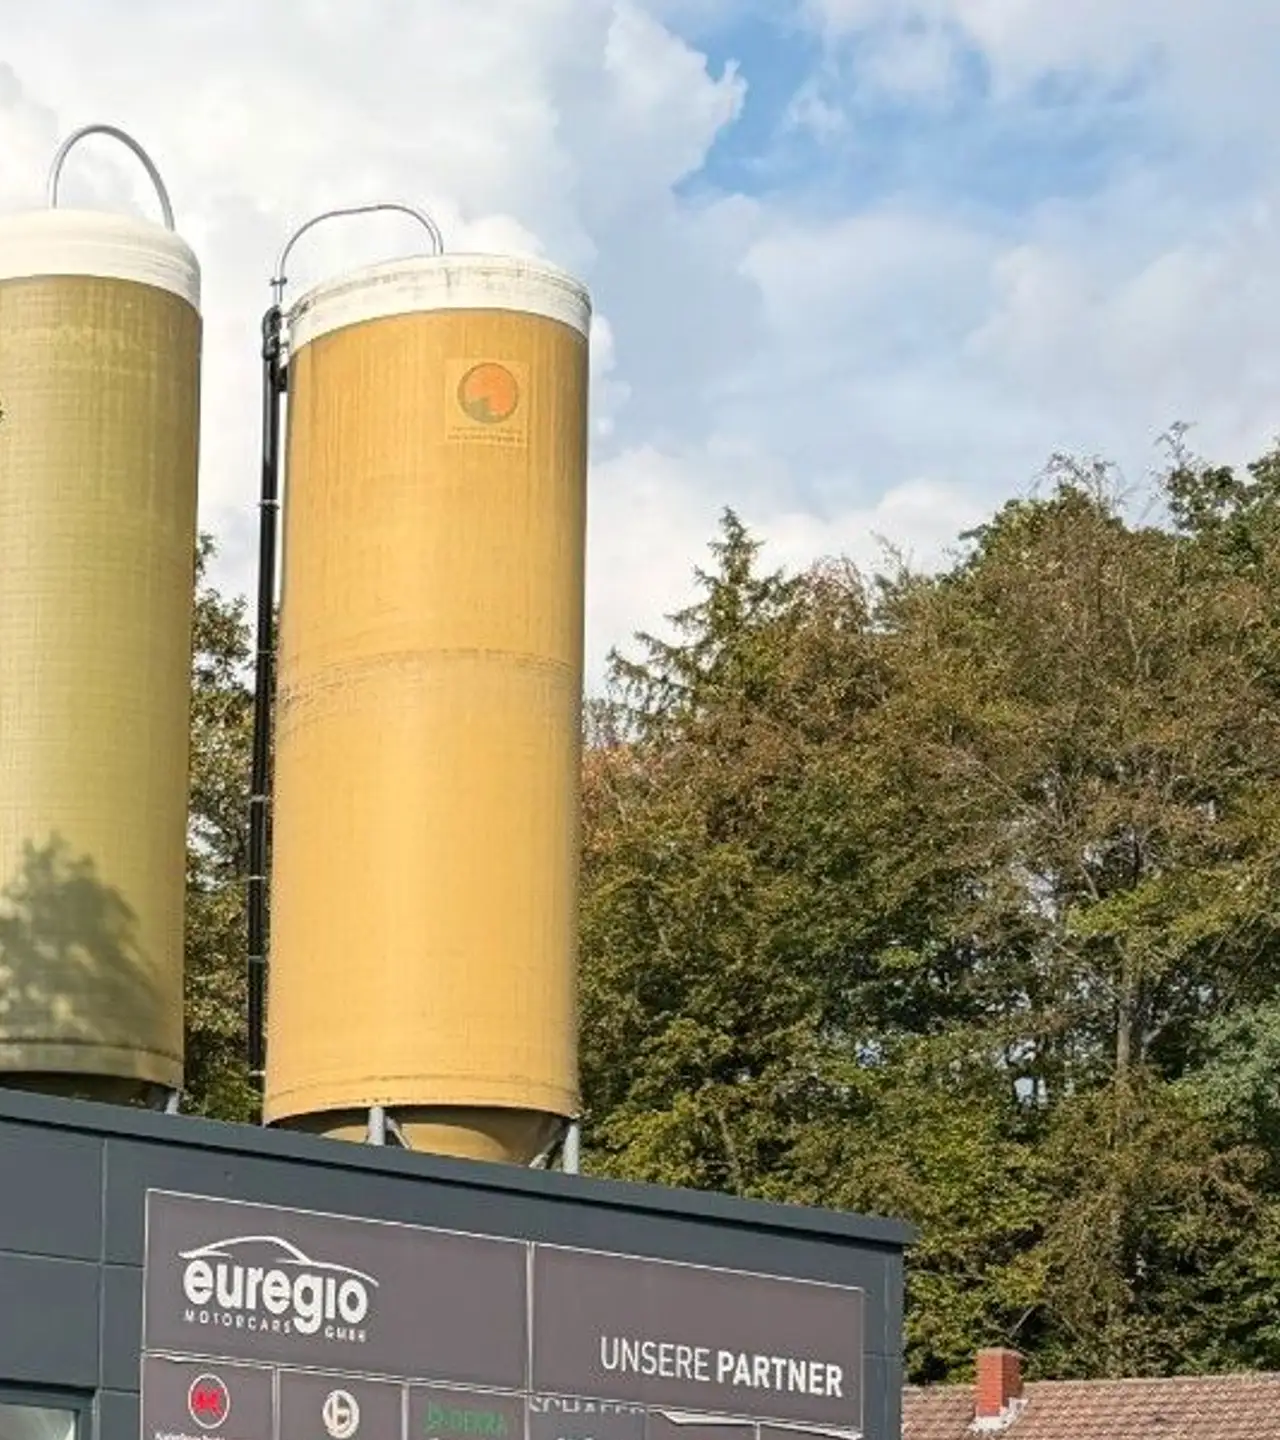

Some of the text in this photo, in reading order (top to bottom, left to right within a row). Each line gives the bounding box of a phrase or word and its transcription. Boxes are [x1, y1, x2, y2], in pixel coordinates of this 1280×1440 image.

[183, 1259, 369, 1335] euregio
[184, 1308, 291, 1334] MOTORCARS
[600, 1336, 843, 1398] UNSERE PARTNER
